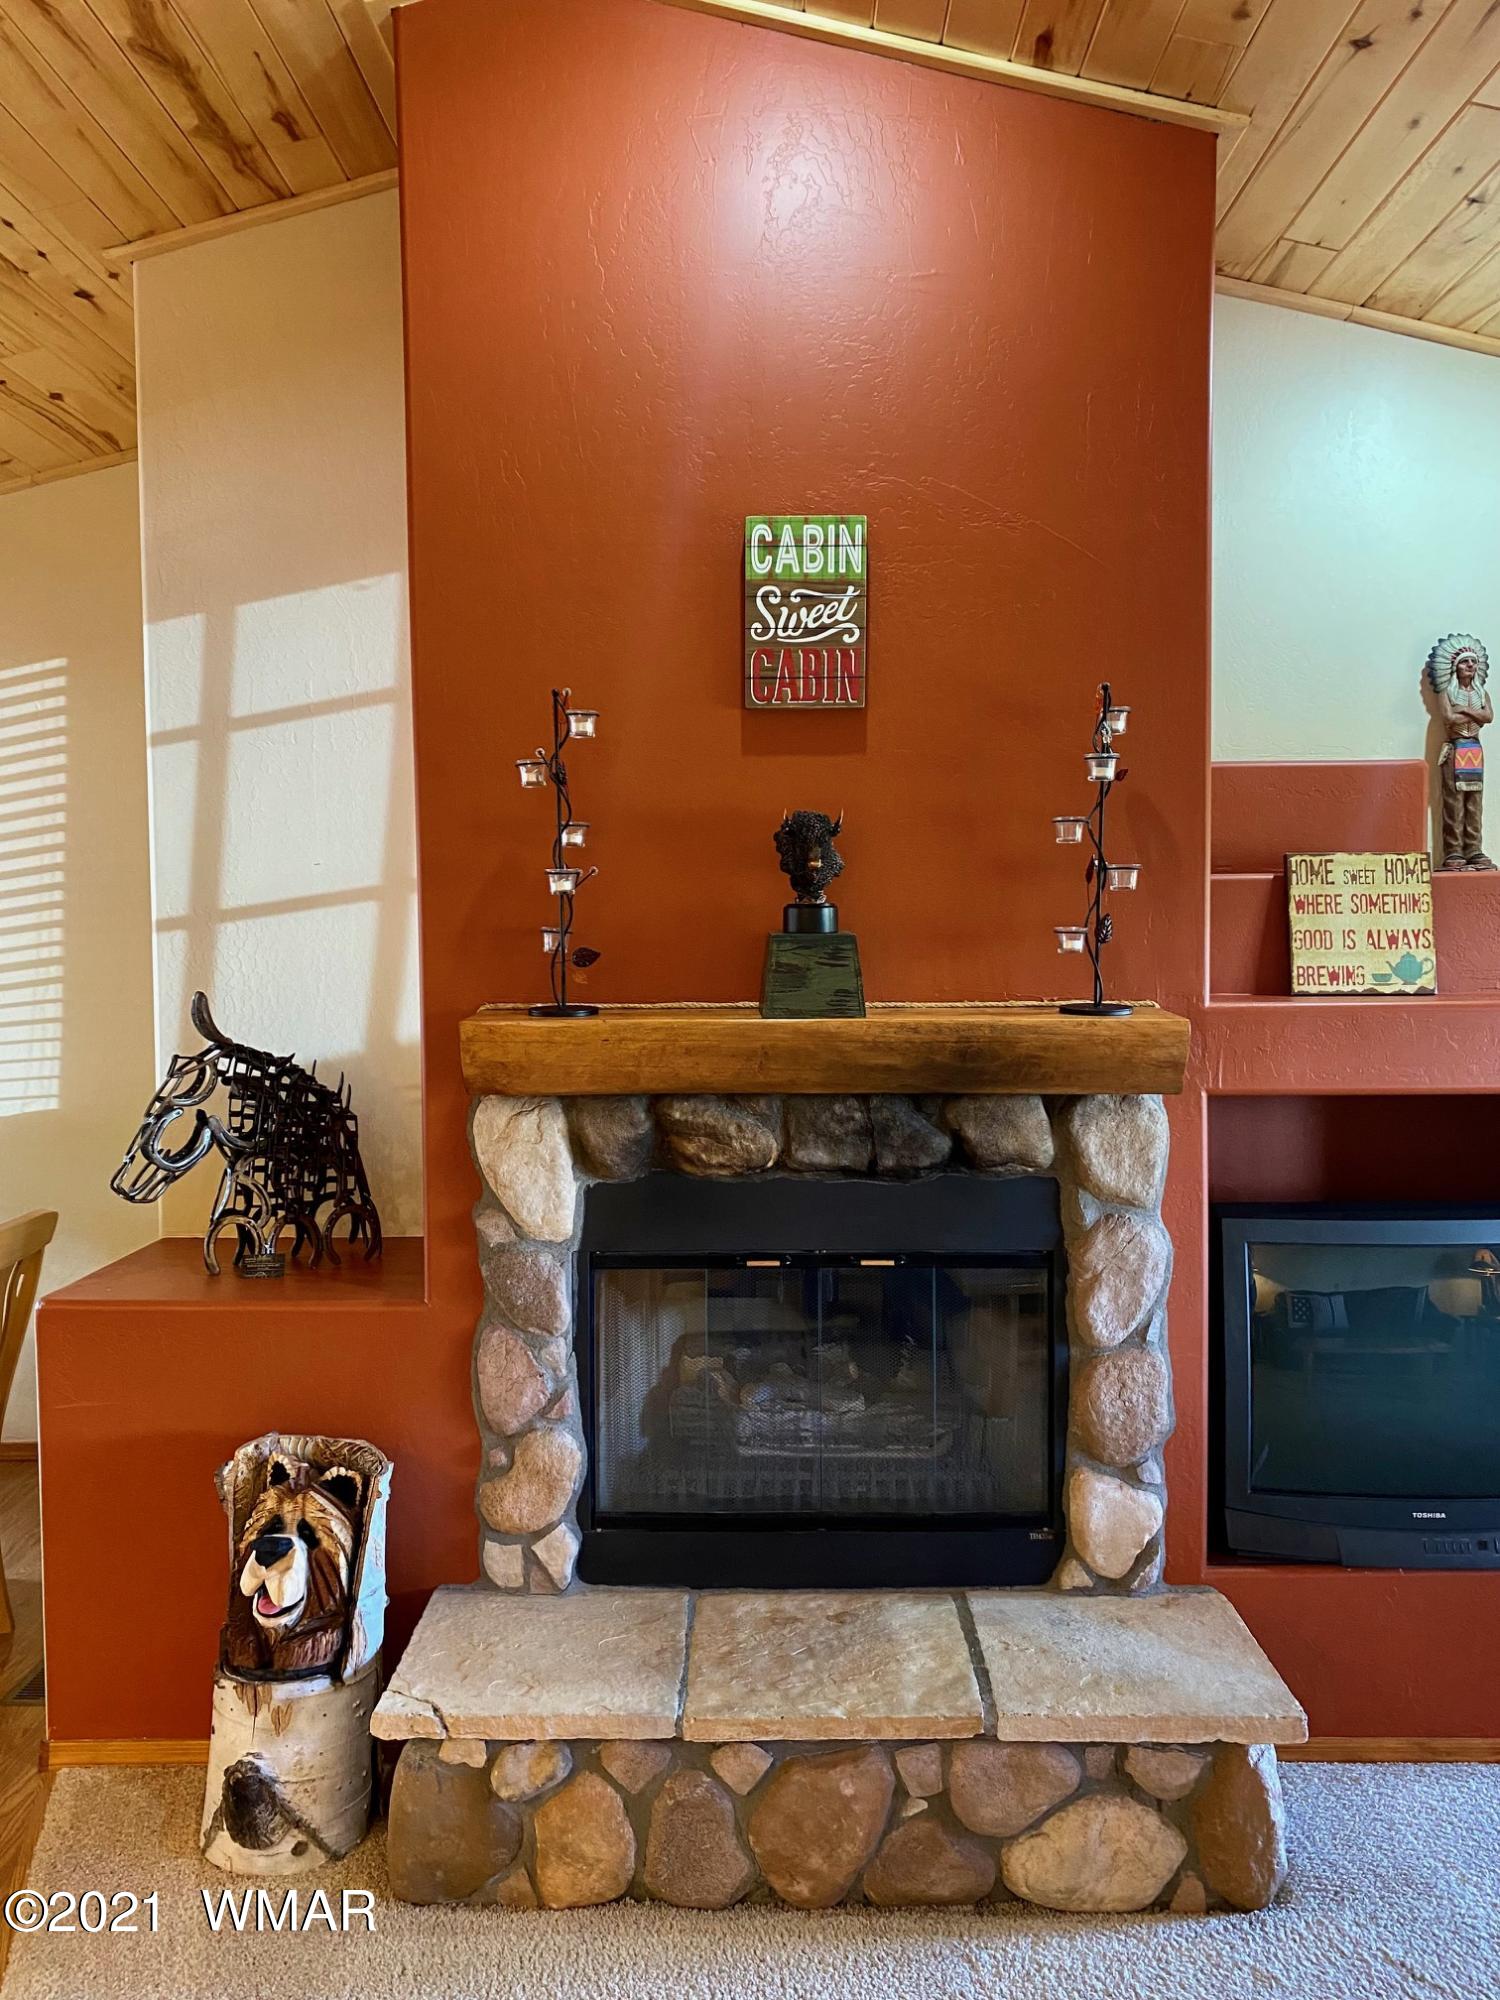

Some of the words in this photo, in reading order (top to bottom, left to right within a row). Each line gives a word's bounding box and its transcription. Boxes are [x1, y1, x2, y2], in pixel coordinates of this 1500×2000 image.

[750, 524, 862, 573] CABIN
[751, 585, 860, 643] Sweet
[751, 648, 861, 704] CABIN
[1290, 858, 1335, 886] HOME
[1343, 868, 1376, 885] SWEET
[1385, 858, 1431, 885] HOME
[1293, 893, 1343, 915] WHERE
[1350, 892, 1430, 915] SOMETHING
[1294, 929, 1333, 951] GOOD
[1342, 929, 1356, 951] IS
[1366, 928, 1431, 950] ALWAYS
[1296, 965, 1365, 986] BREWING
